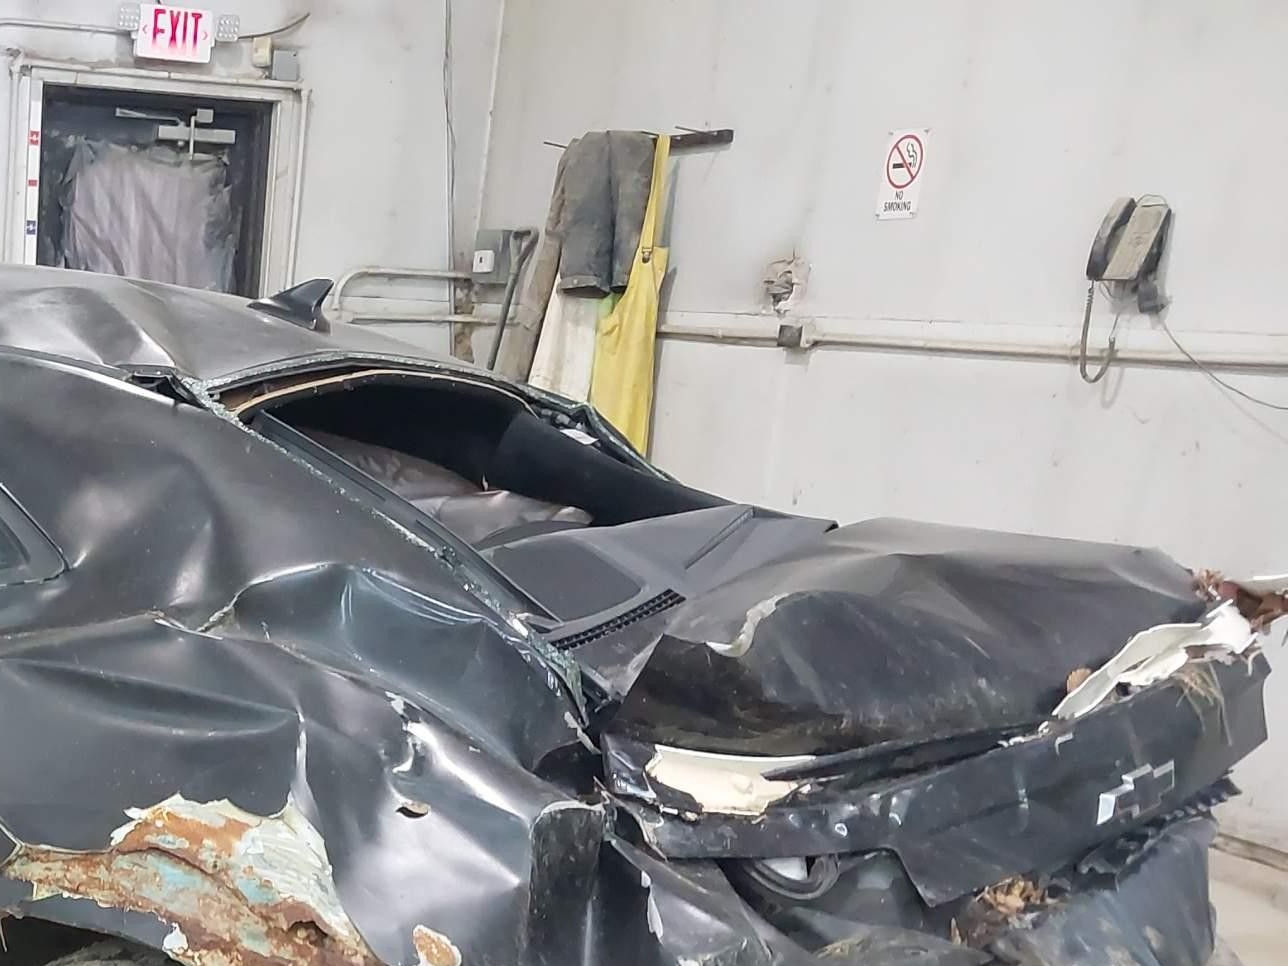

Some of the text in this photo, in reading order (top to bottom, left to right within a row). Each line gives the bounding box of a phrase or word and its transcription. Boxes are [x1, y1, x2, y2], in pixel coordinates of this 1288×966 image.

[152, 8, 203, 56] EXIT
[895, 190, 904, 200] NO
[883, 201, 912, 212] SMOKING
